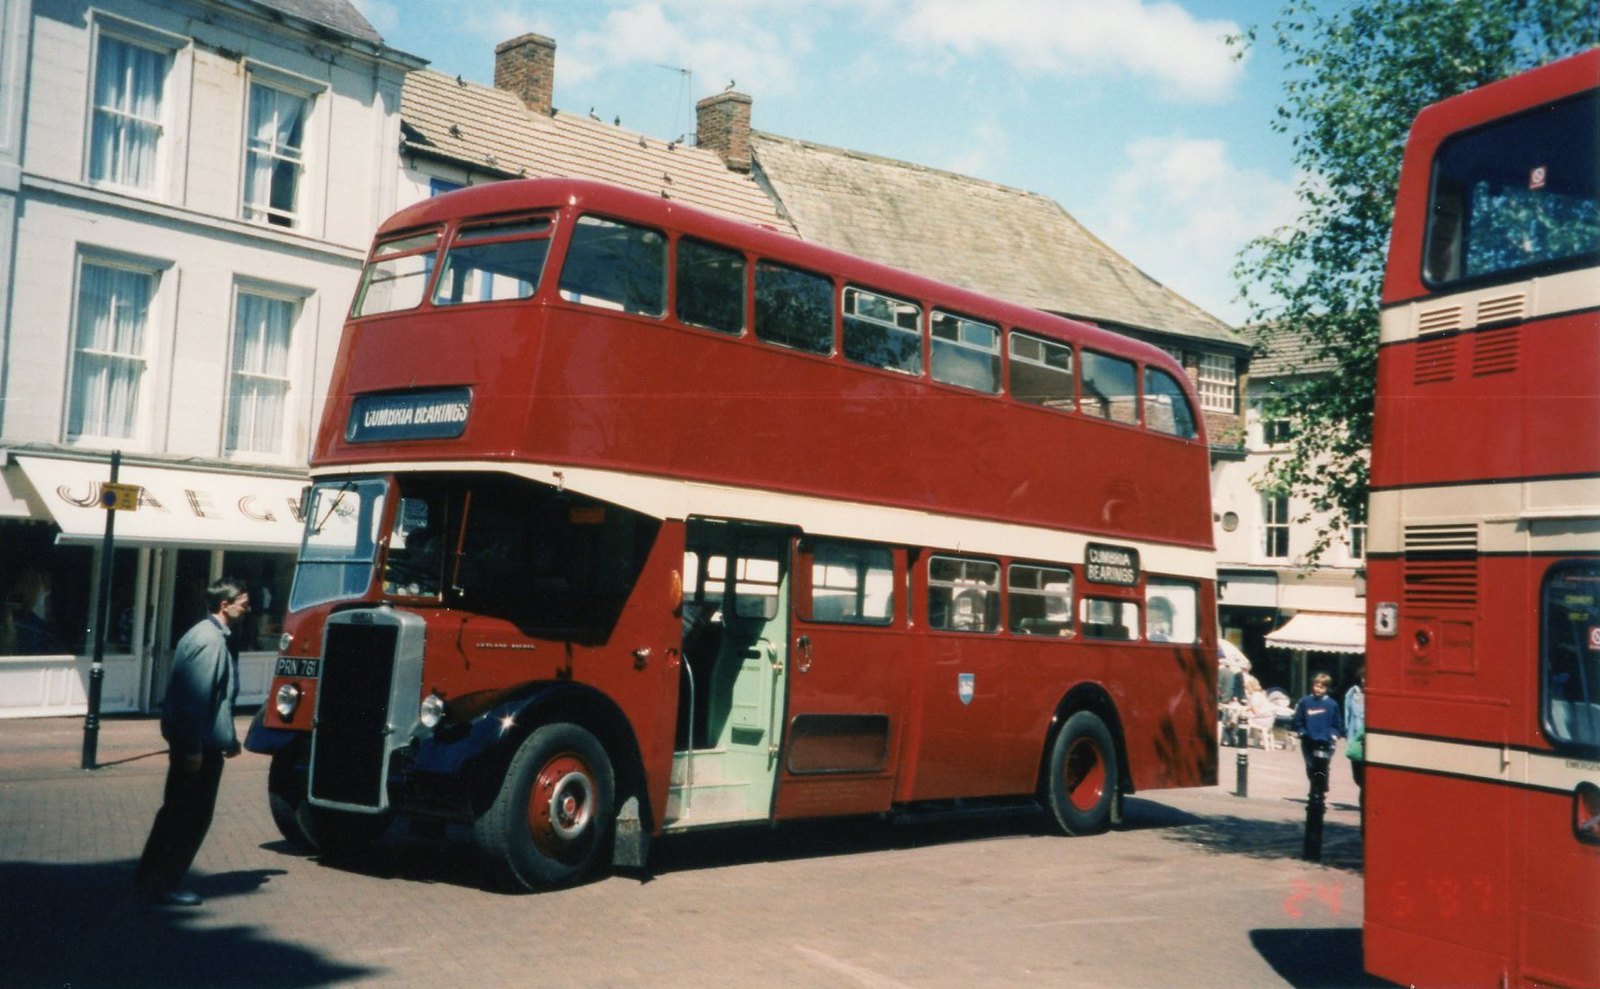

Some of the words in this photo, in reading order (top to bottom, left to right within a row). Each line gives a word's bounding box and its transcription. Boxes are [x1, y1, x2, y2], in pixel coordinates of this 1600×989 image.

[364, 407, 413, 428] CUMBRIA
[413, 402, 469, 425] BEARINGS
[1089, 549, 1131, 565] CUMBRIA
[1088, 565, 1134, 583] BEARINGS
[276, 658, 298, 675] PRN
[300, 659, 318, 676] 761
